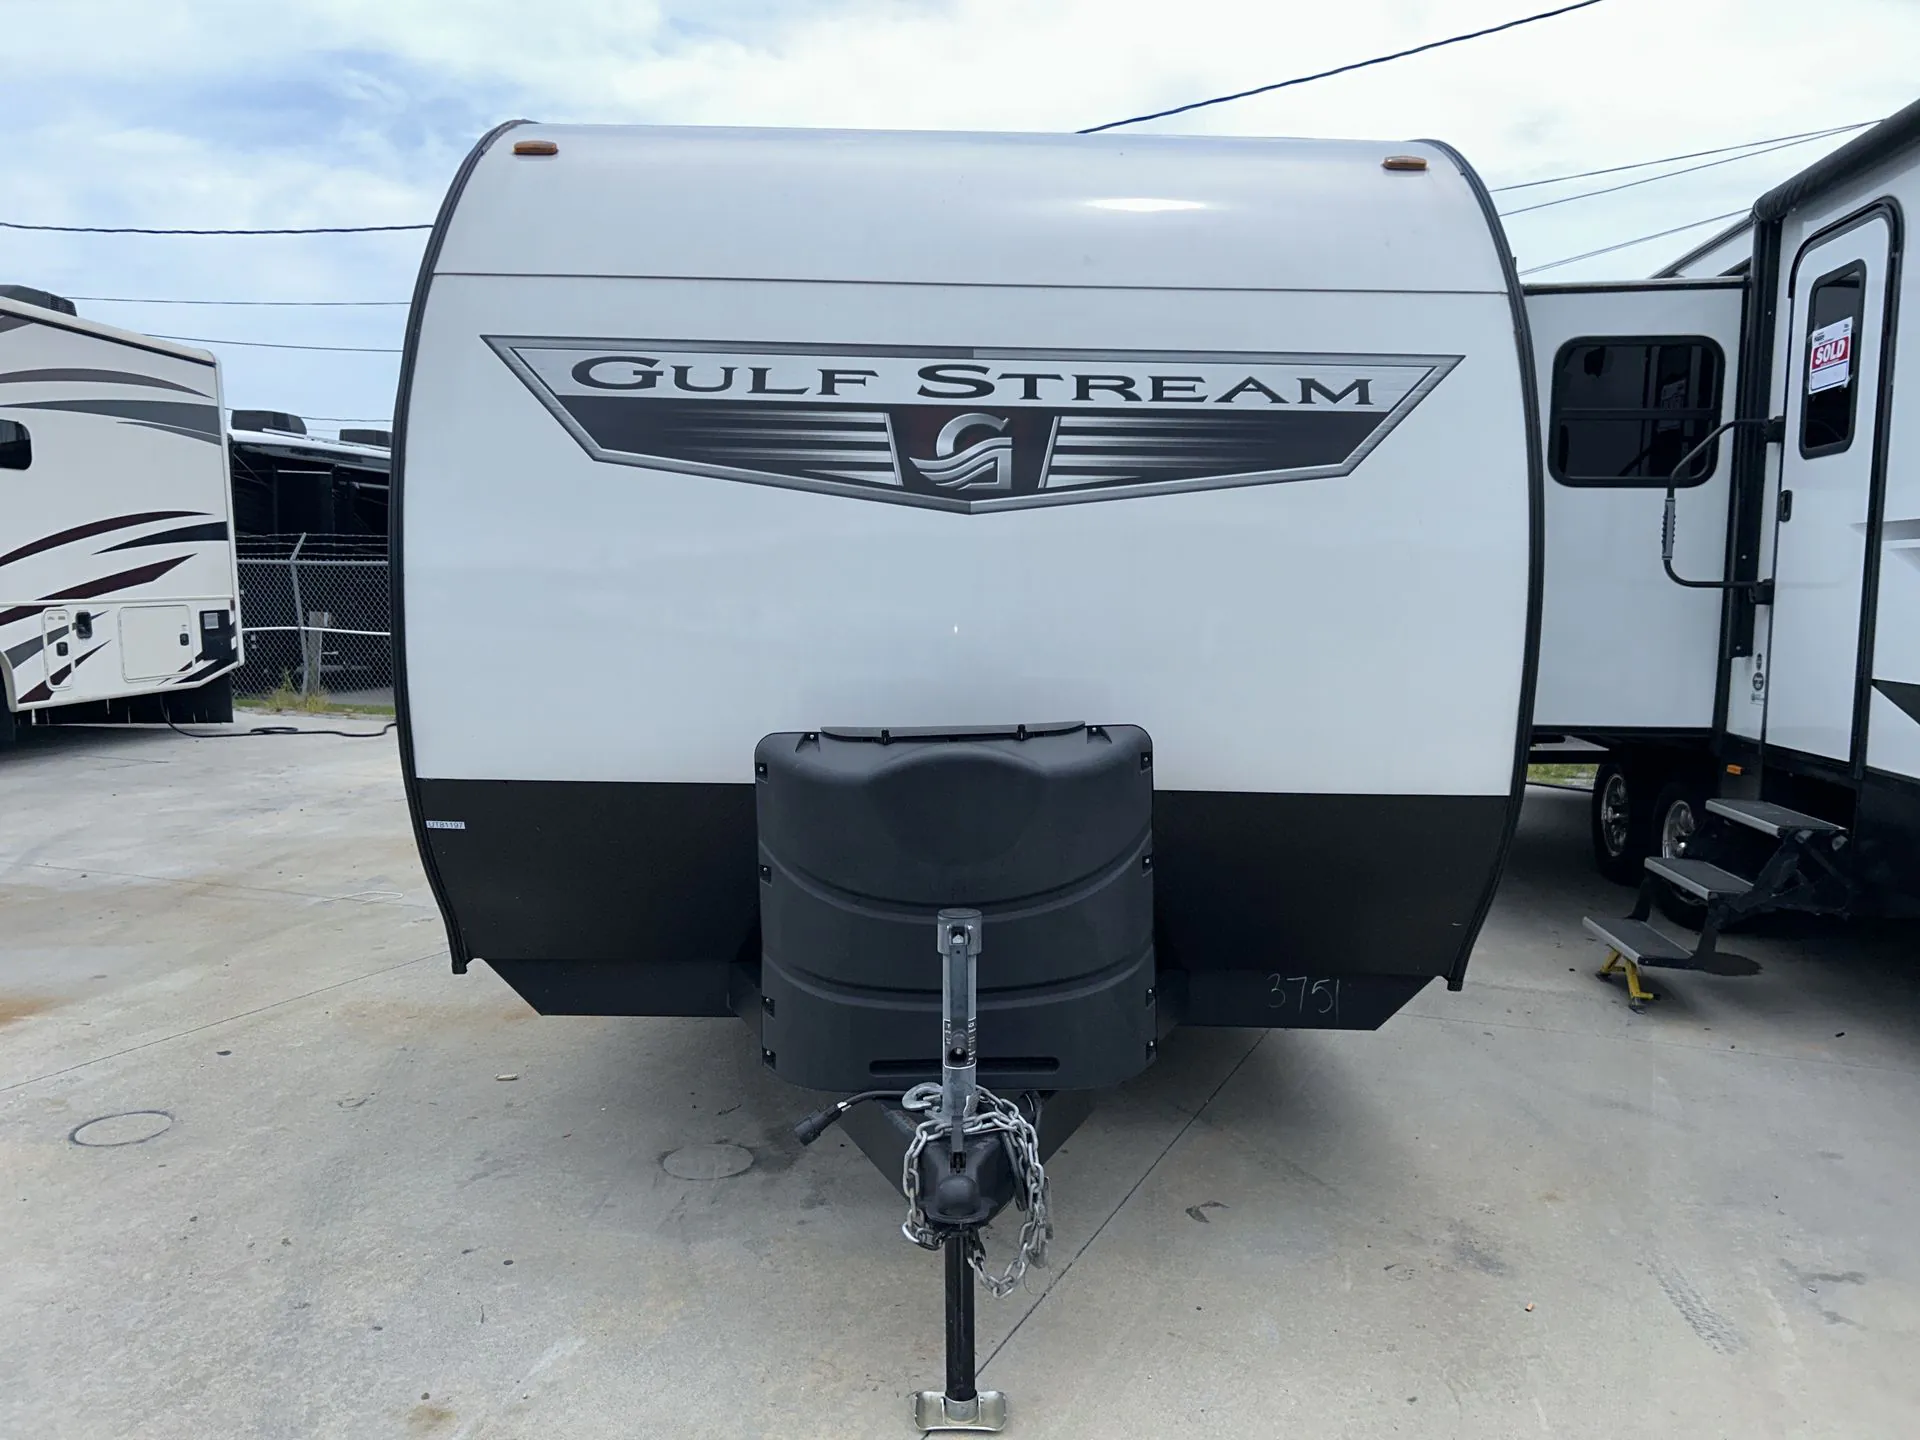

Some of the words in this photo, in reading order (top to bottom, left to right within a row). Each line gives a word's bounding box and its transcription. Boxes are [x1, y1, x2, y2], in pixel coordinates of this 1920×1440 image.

[1815, 339, 1846, 366] SOLD
[571, 355, 879, 396] GULF
[917, 364, 1374, 406] STREAM
[1266, 973, 1340, 1024] 3751
